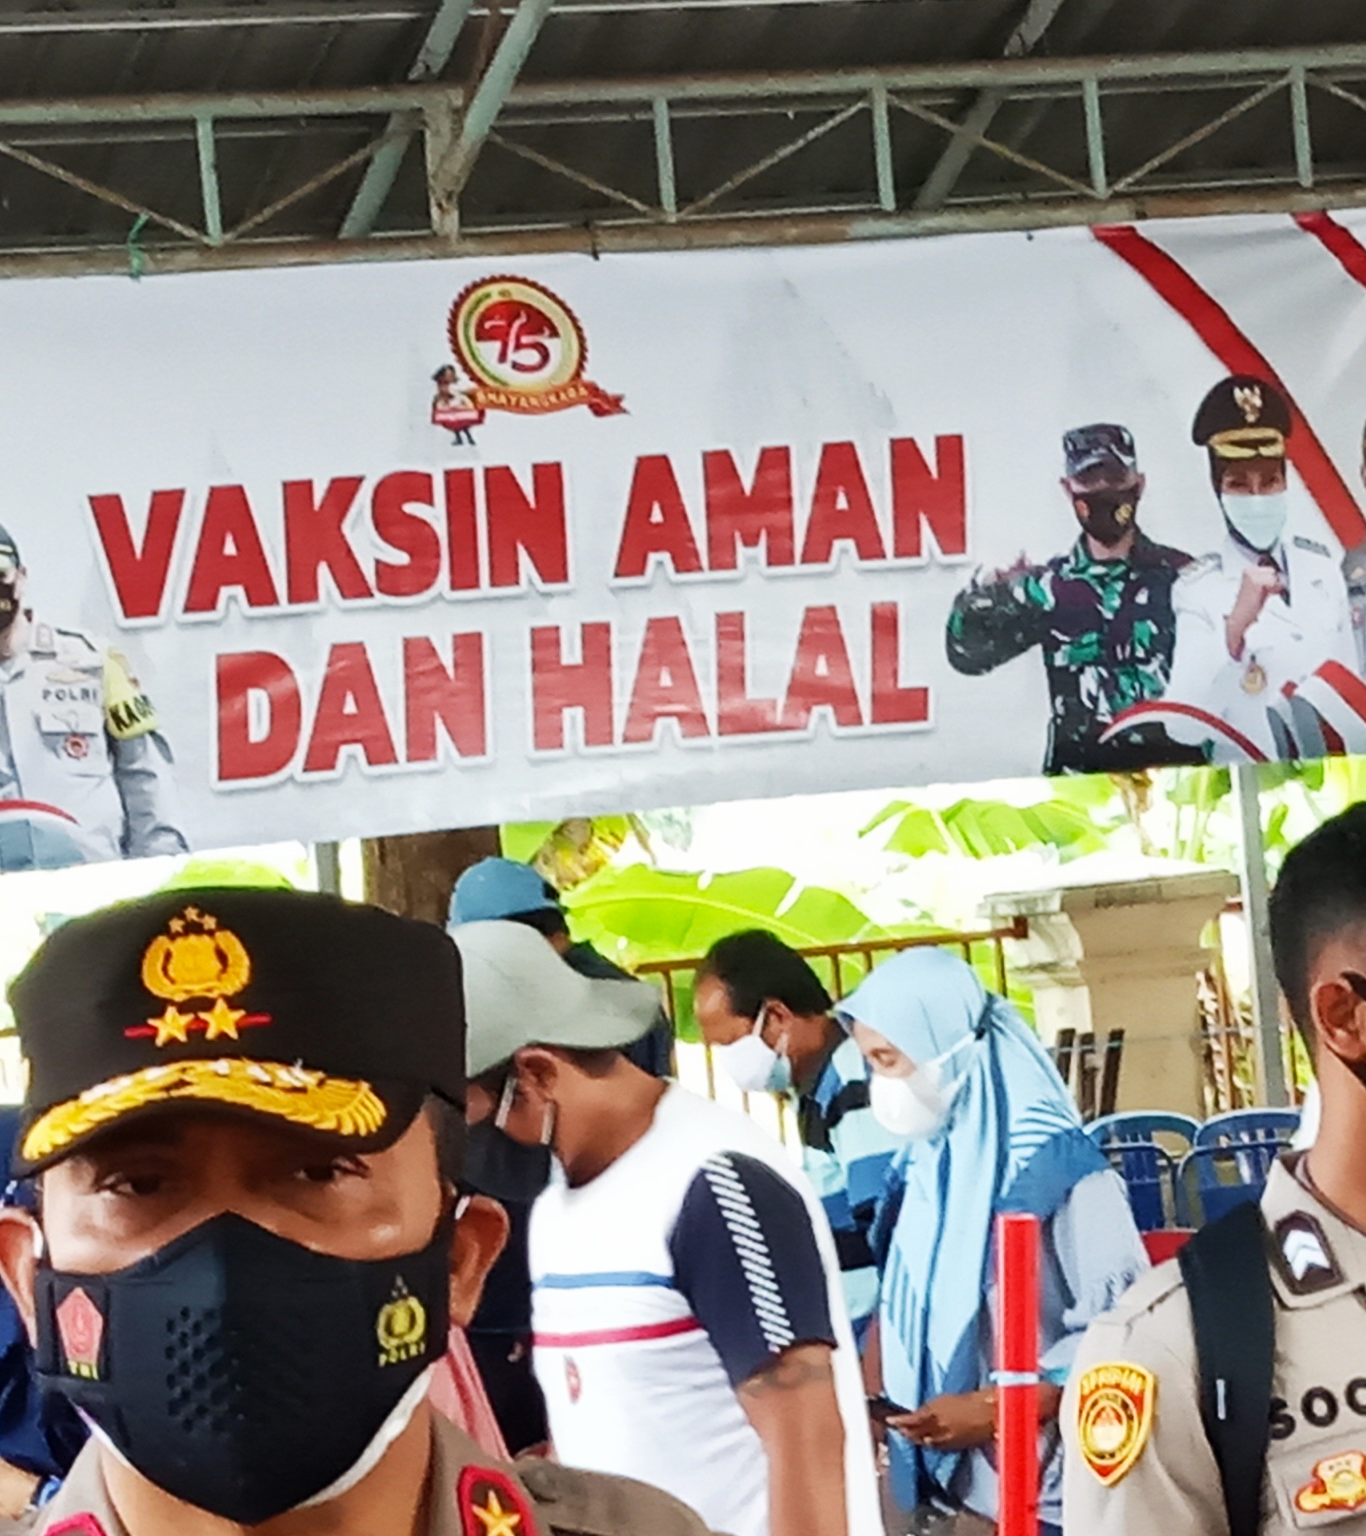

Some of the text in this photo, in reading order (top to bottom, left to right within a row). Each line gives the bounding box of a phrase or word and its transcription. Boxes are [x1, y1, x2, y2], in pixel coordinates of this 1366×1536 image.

[88, 434, 968, 620] VAKSIN AMAN
[42, 688, 98, 701] POLRI
[215, 602, 930, 783] DAN HALAL
[378, 1342, 425, 1367] POLRI
[67, 1361, 99, 1380] TNI
